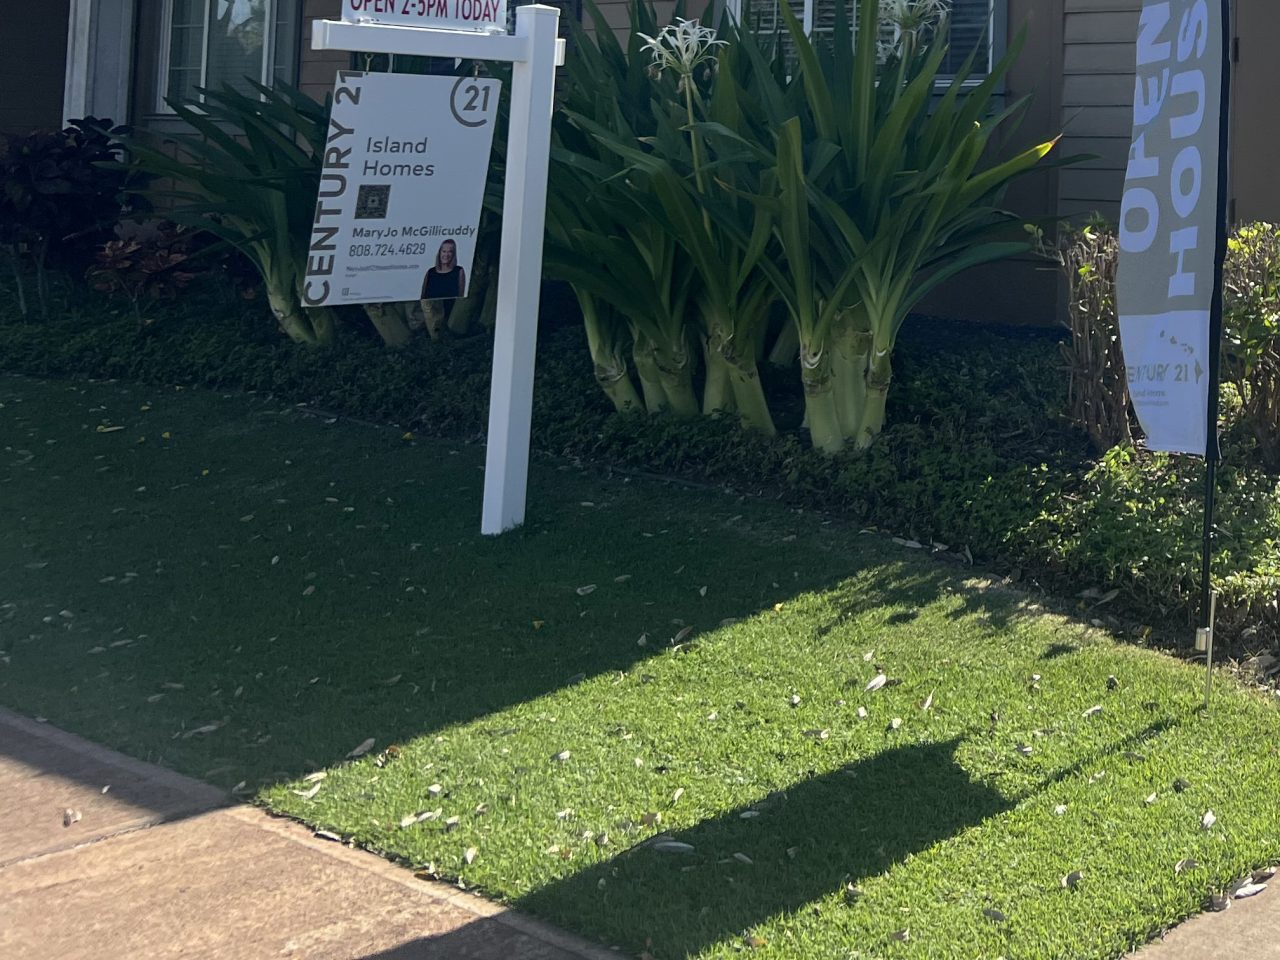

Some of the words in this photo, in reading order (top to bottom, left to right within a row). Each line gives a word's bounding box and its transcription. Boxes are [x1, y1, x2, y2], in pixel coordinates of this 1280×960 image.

[463, 85, 490, 112] 21
[366, 136, 428, 154] Island
[363, 159, 435, 177] Homes
[303, 118, 355, 305] CENTURY
[335, 70, 364, 105] 21
[352, 226, 398, 240] MaryJo
[401, 225, 476, 238] McGillicuddy
[349, 242, 426, 257] 808.724.4629
[1174, 363, 1188, 382] 21
